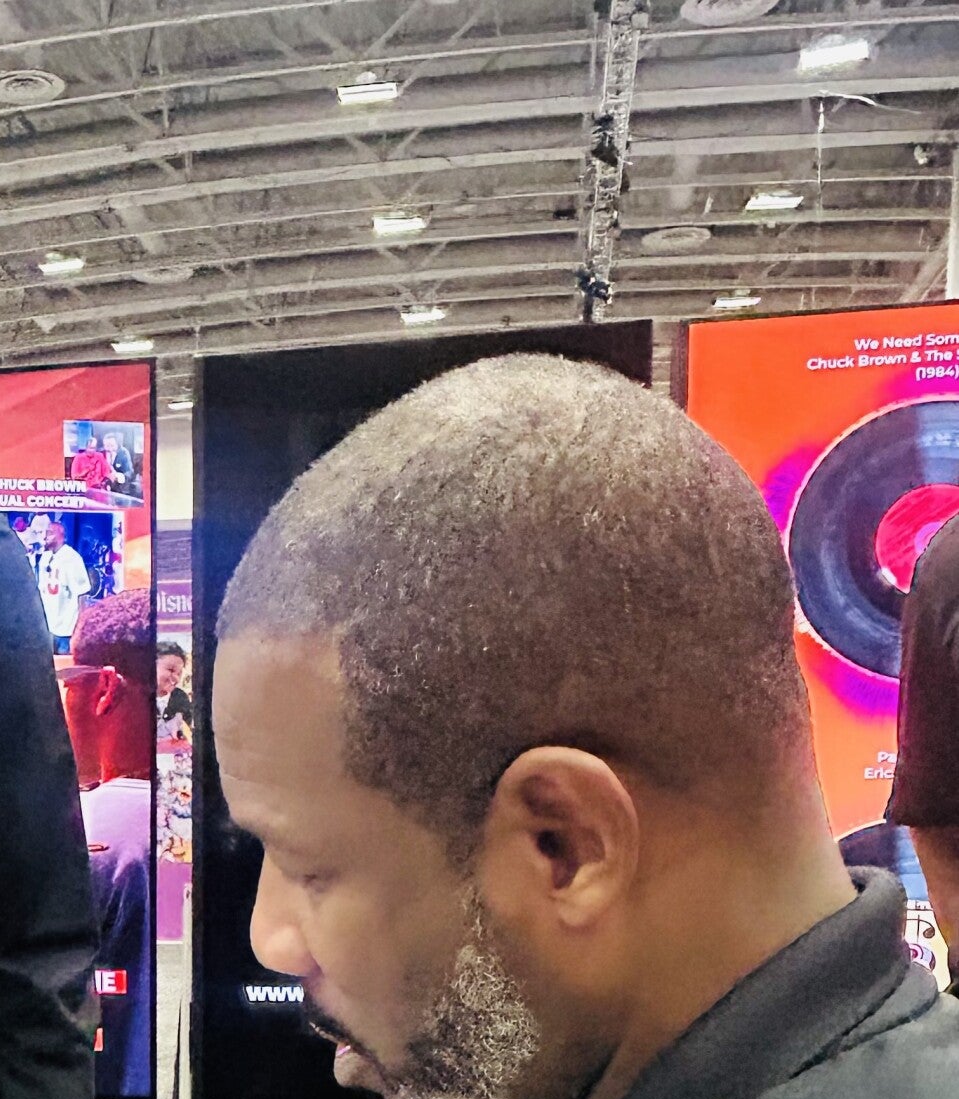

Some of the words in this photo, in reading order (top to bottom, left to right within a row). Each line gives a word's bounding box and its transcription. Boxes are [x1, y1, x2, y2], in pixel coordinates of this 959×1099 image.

[854, 338, 880, 351] We
[883, 334, 922, 349] Need
[806, 356, 855, 371] Chuck
[858, 354, 907, 368] Brown
[910, 351, 922, 363] &
[924, 349, 954, 362] The
[915, 365, 959, 381] (1984)
[36, 480, 87, 493] BROWN
[26, 495, 86, 508] CONCERT
